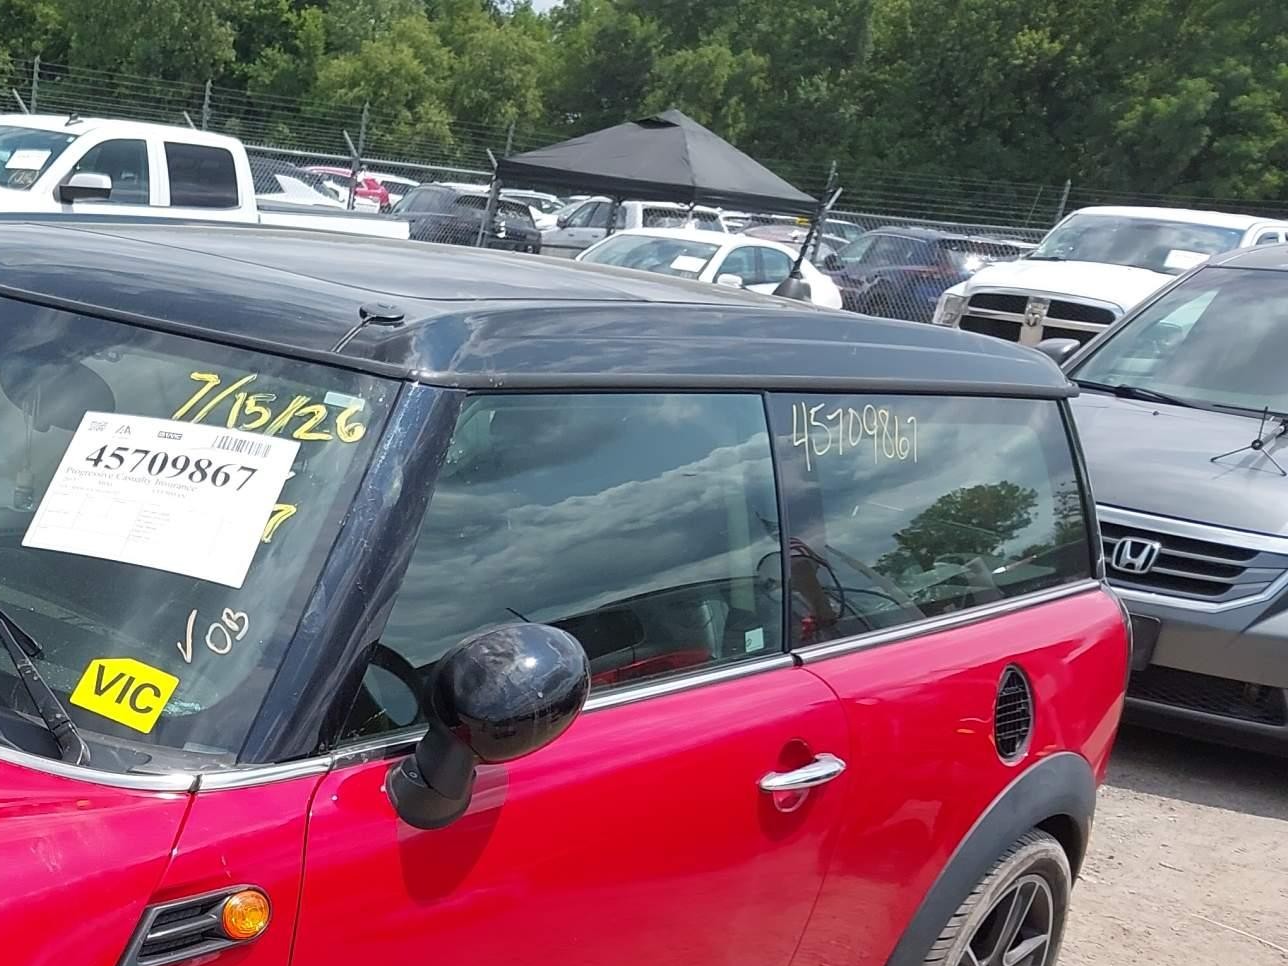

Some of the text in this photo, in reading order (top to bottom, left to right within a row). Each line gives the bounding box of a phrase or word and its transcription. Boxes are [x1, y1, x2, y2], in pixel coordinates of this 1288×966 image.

[172, 372, 366, 443] 7/15/26
[792, 401, 918, 472] 45709867
[85, 444, 259, 492] 45709867
[93, 664, 162, 714] VIC
